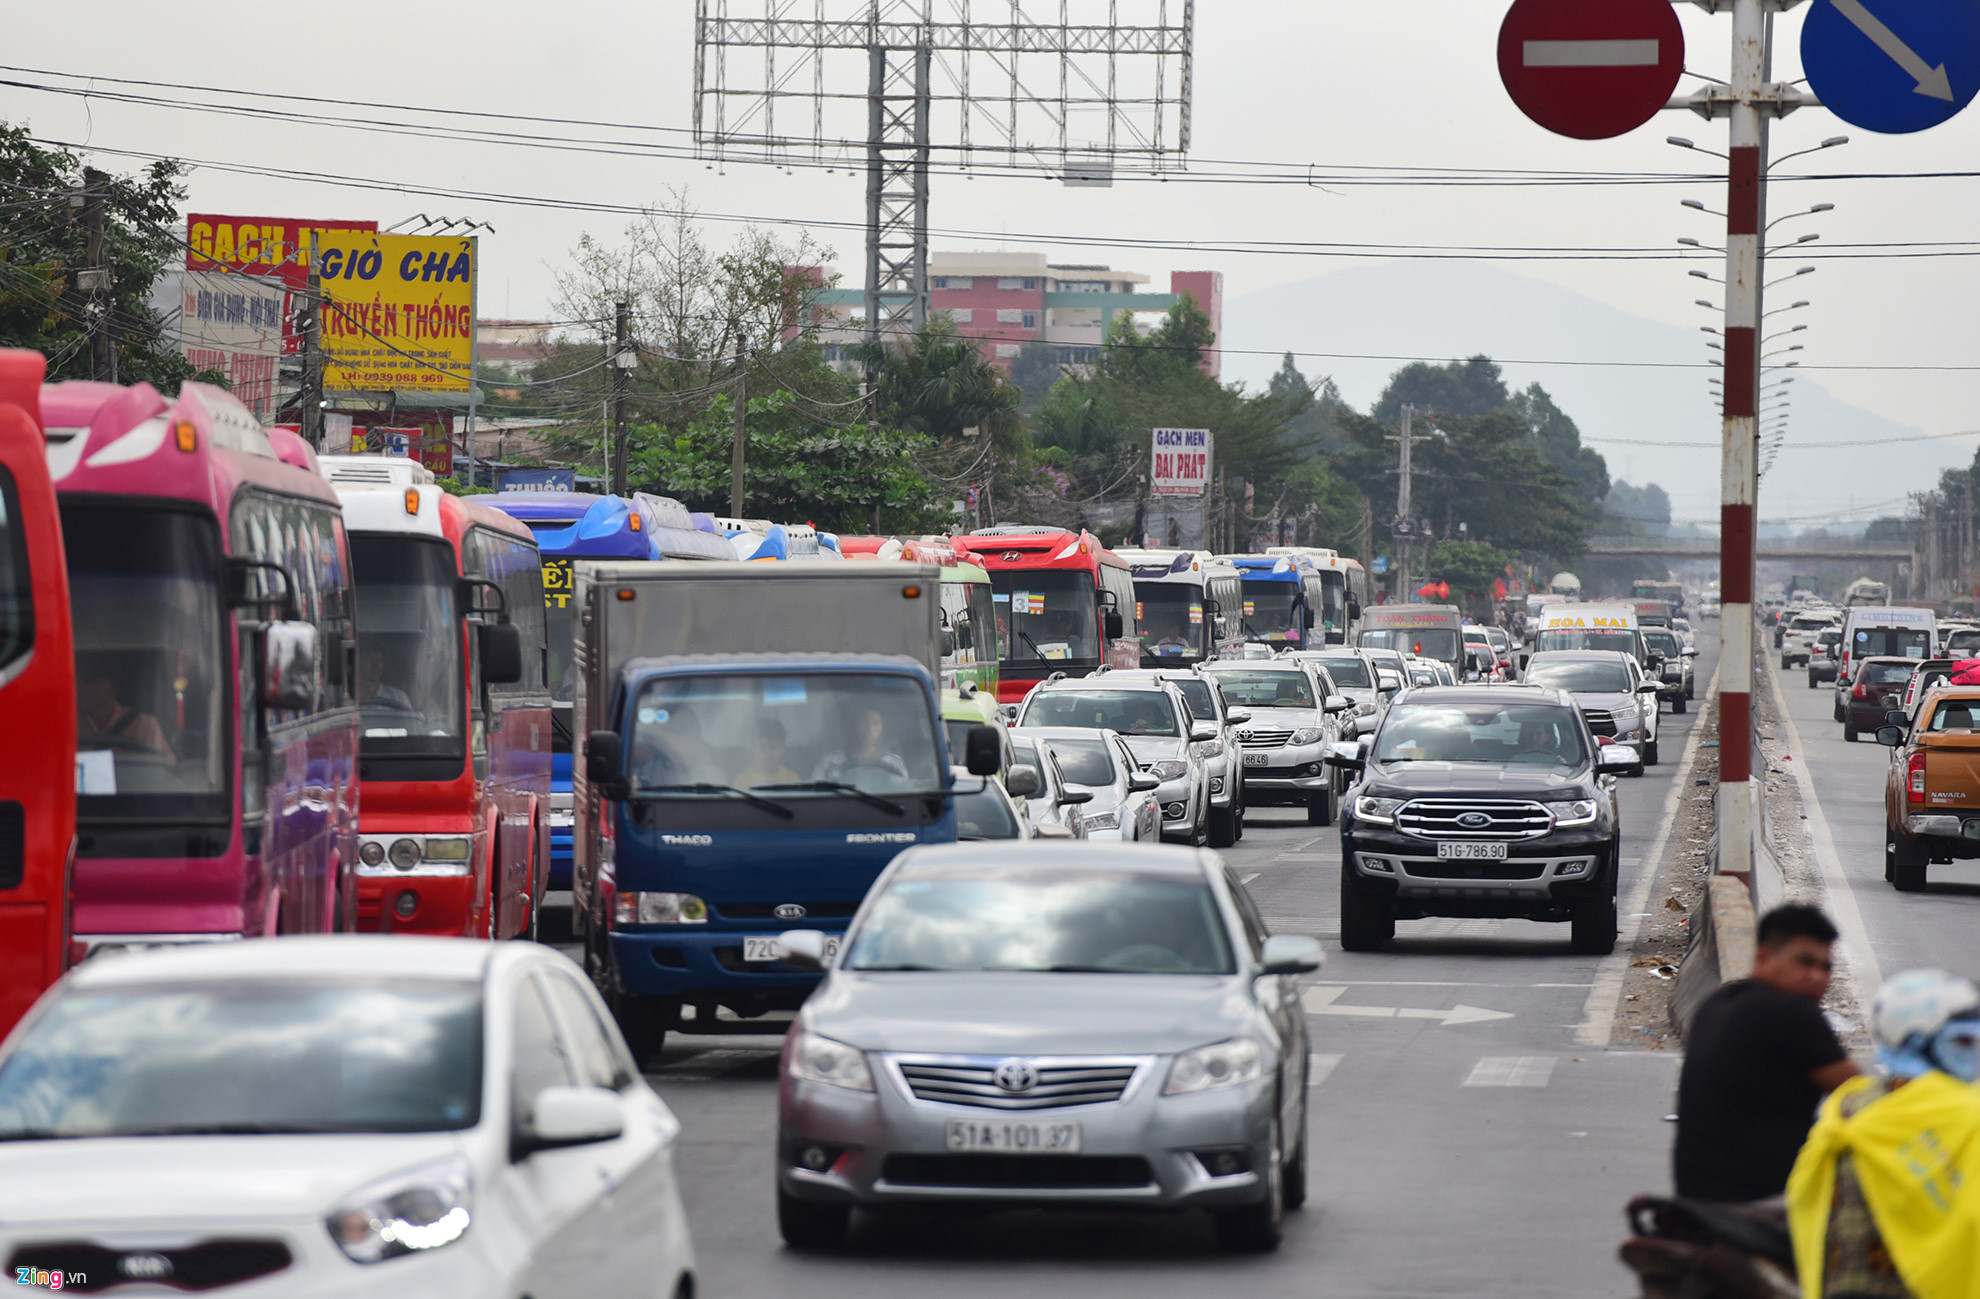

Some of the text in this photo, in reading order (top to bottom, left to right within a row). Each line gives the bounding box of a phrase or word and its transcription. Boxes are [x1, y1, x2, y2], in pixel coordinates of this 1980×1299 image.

[190, 222, 285, 273] GẠCH
[320, 238, 470, 282] GIÒ CHẢ
[320, 291, 470, 341] TRUYỀN THỐNG
[364, 373, 393, 381] 0939
[395, 373, 417, 382] 088
[421, 374, 443, 383] 969
[1157, 430, 1205, 449] GẠCH MEN
[1549, 617, 1628, 627] HOA MAI
[661, 834, 712, 845] THACO
[846, 833, 916, 844] FRONTIER
[1439, 844, 1505, 858] 51G-786.90
[950, 1121, 1074, 1148] 51A-101.37
